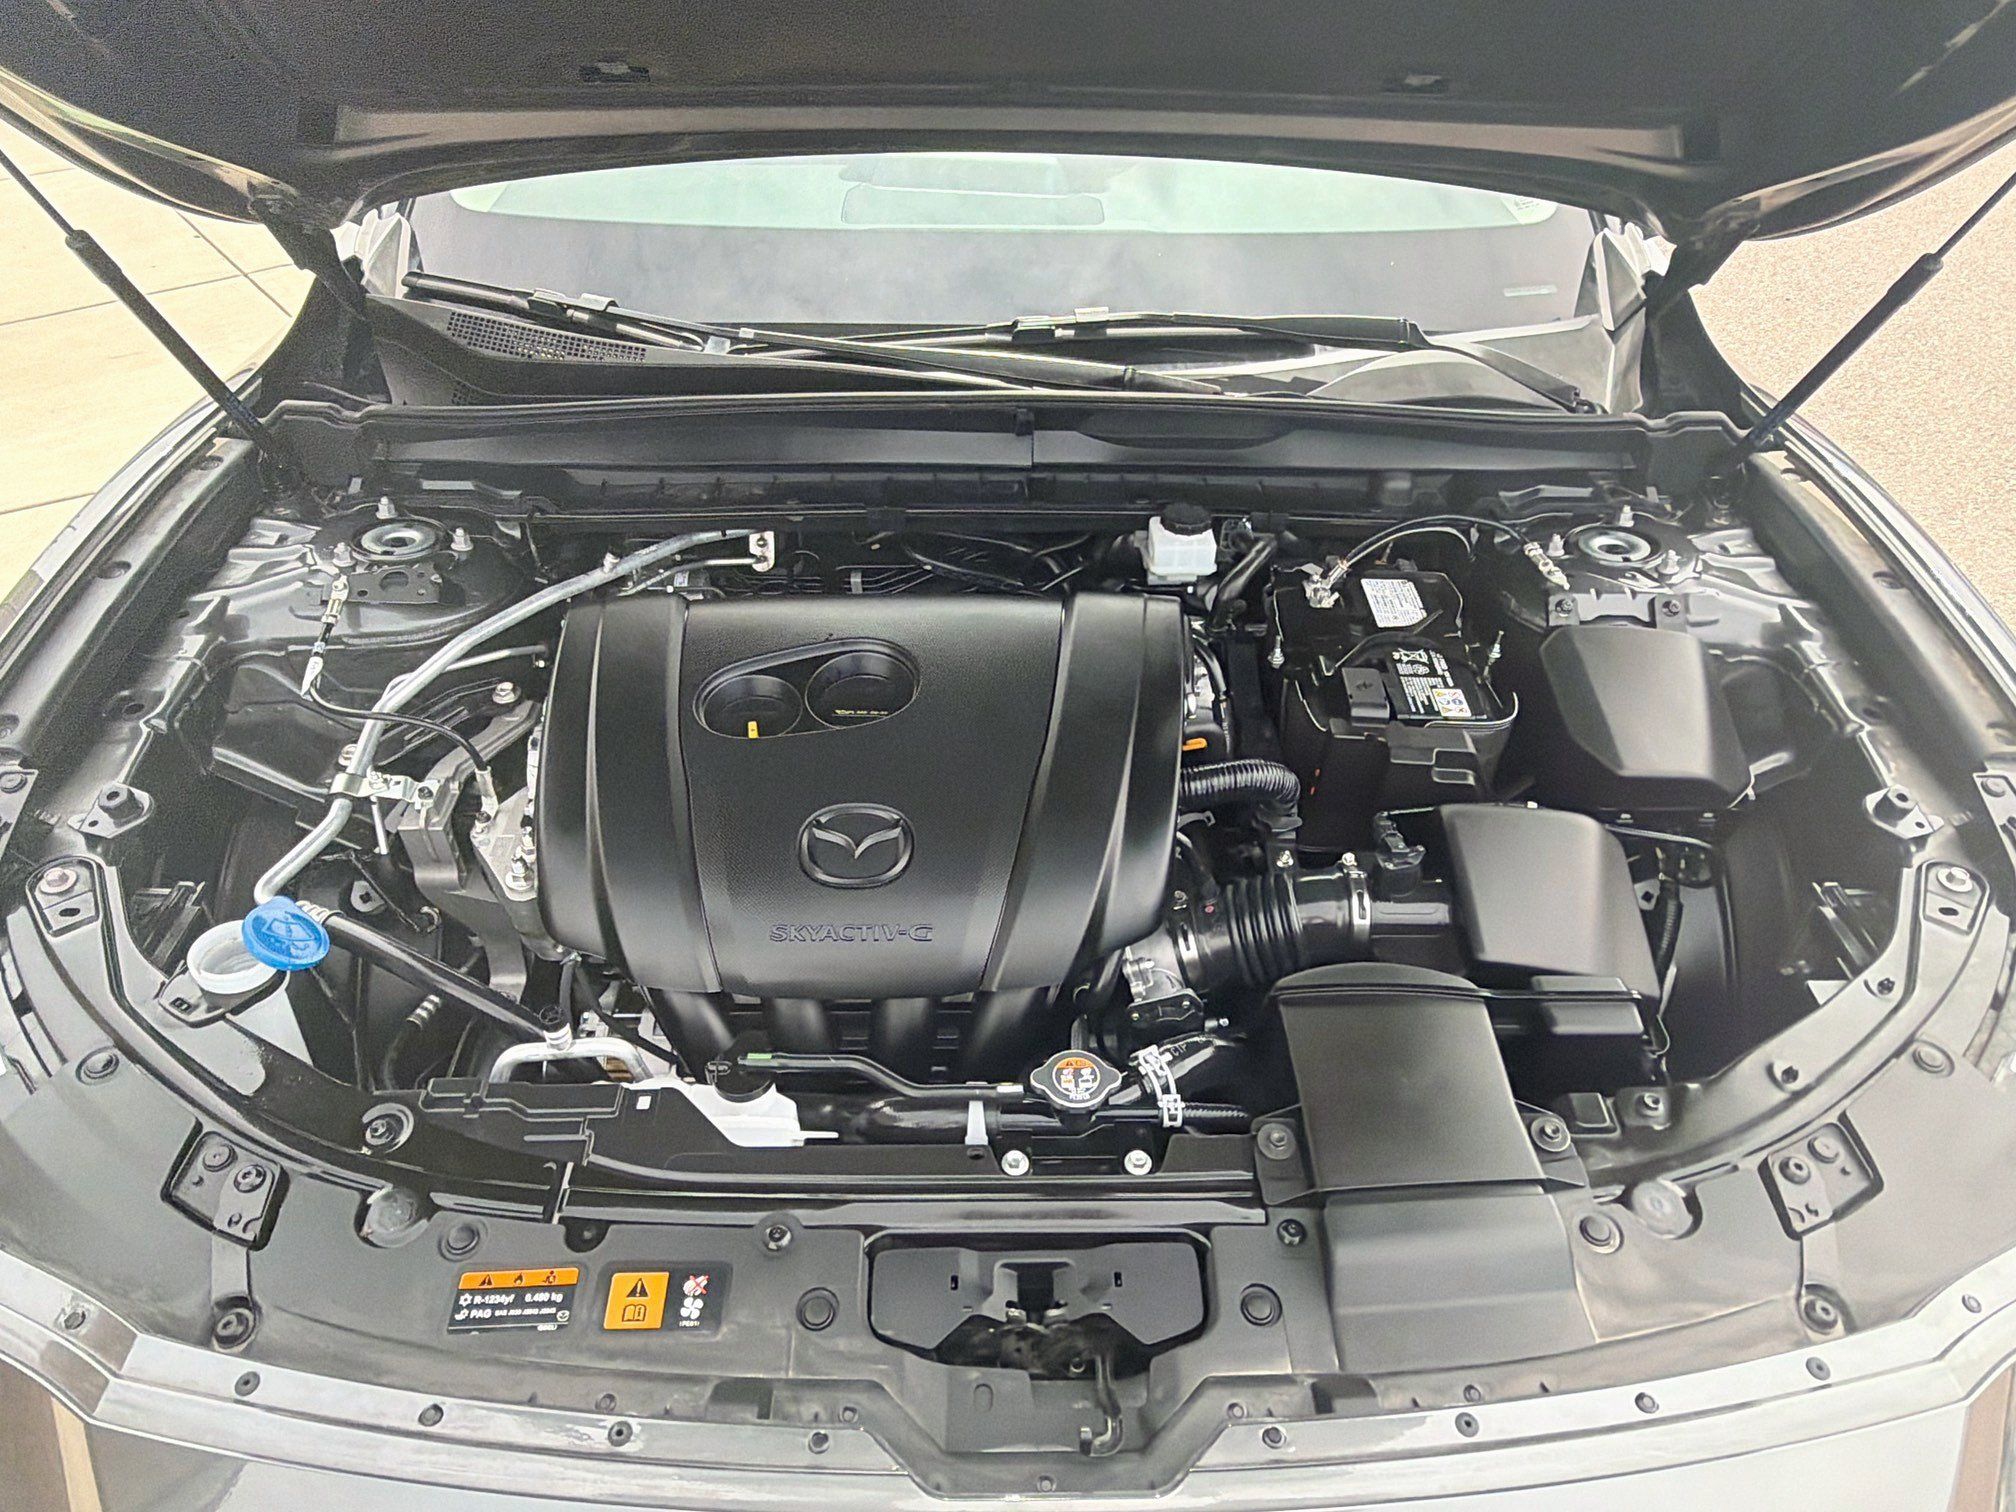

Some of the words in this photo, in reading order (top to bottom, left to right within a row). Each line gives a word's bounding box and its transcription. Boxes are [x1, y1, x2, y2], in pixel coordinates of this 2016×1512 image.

[770, 923, 934, 942] SKYACTIV-G
[550, 1292, 564, 1303] kg
[470, 1308, 492, 1319] PAG
